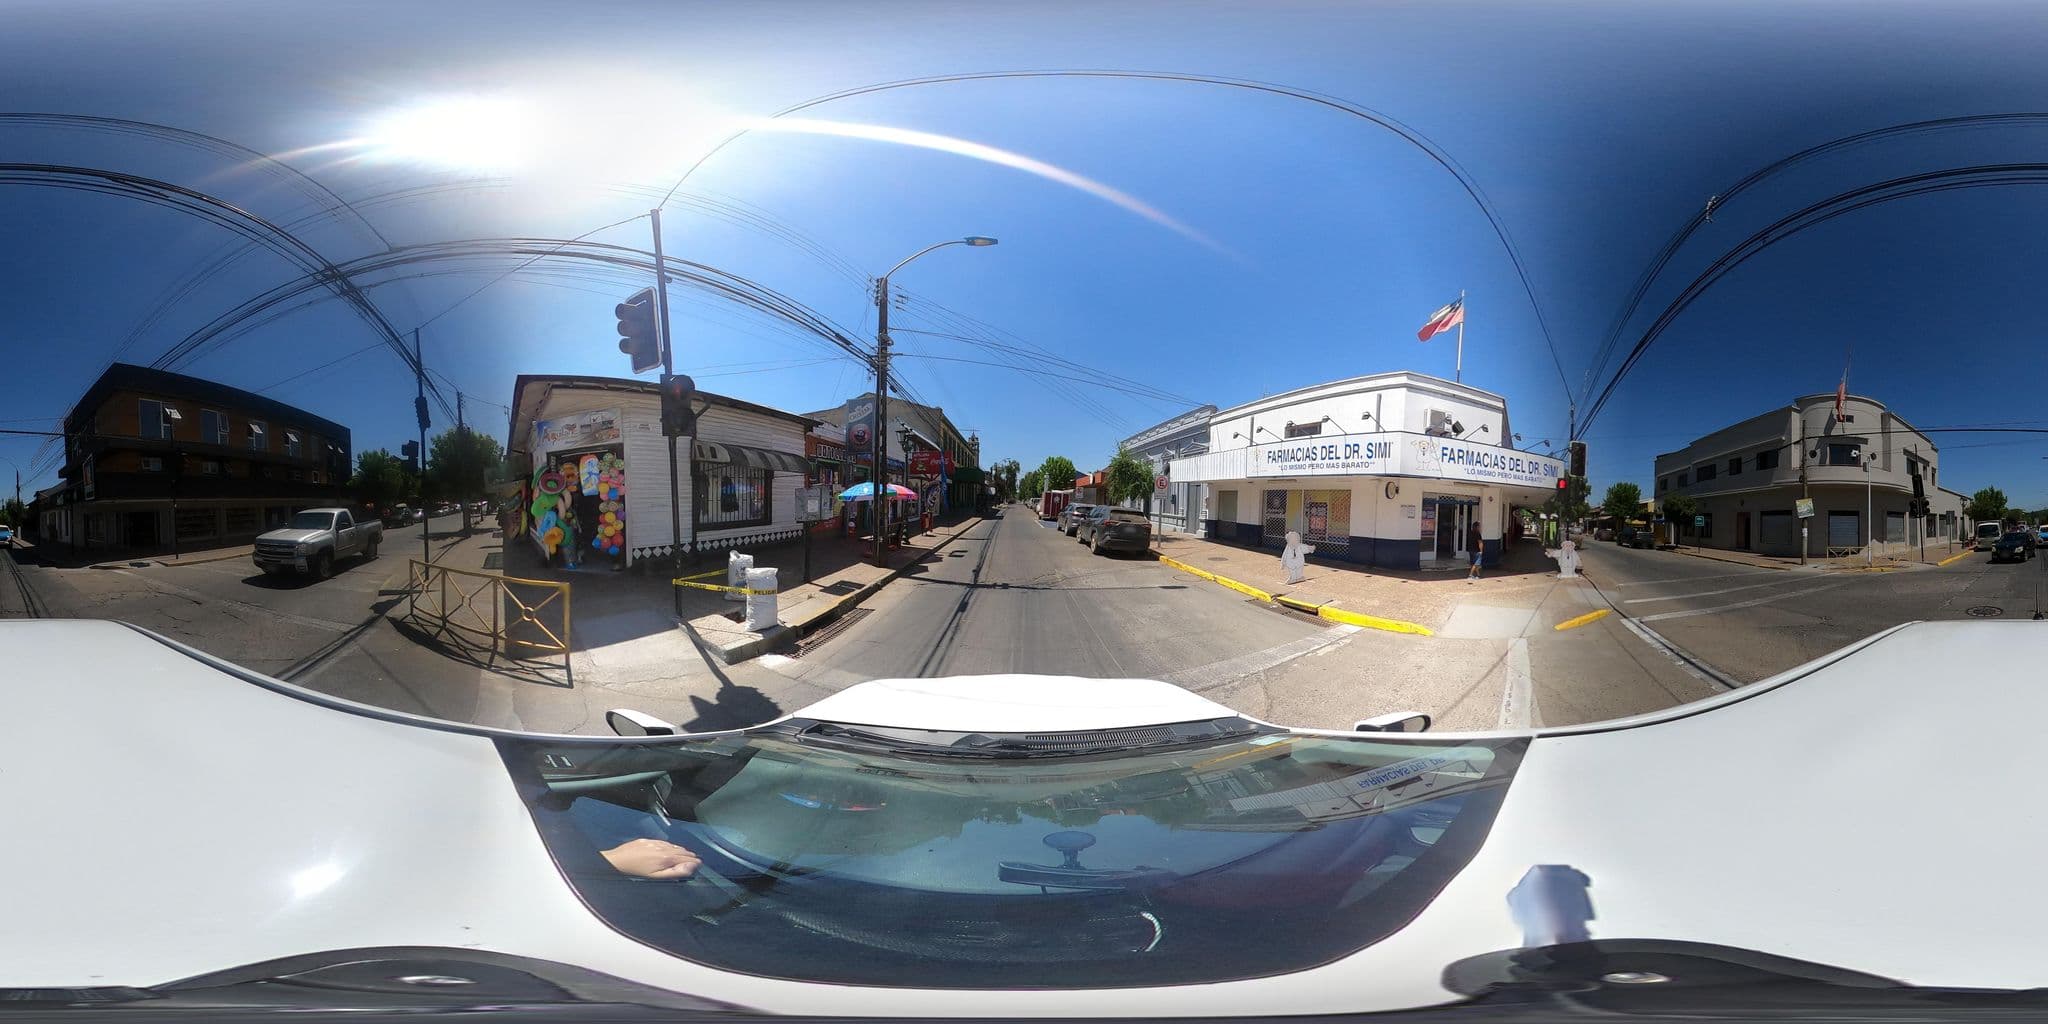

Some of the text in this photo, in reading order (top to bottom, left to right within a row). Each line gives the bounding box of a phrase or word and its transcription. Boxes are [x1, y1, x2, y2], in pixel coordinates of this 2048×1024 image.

[1267, 441, 1391, 464] FARMACIAS DEL DR. SIMI
[1441, 446, 1559, 478] FARMACIAS DEL DR. SIMI
[1477, 469, 1497, 478] MISMO
[1497, 471, 1513, 479] PERO
